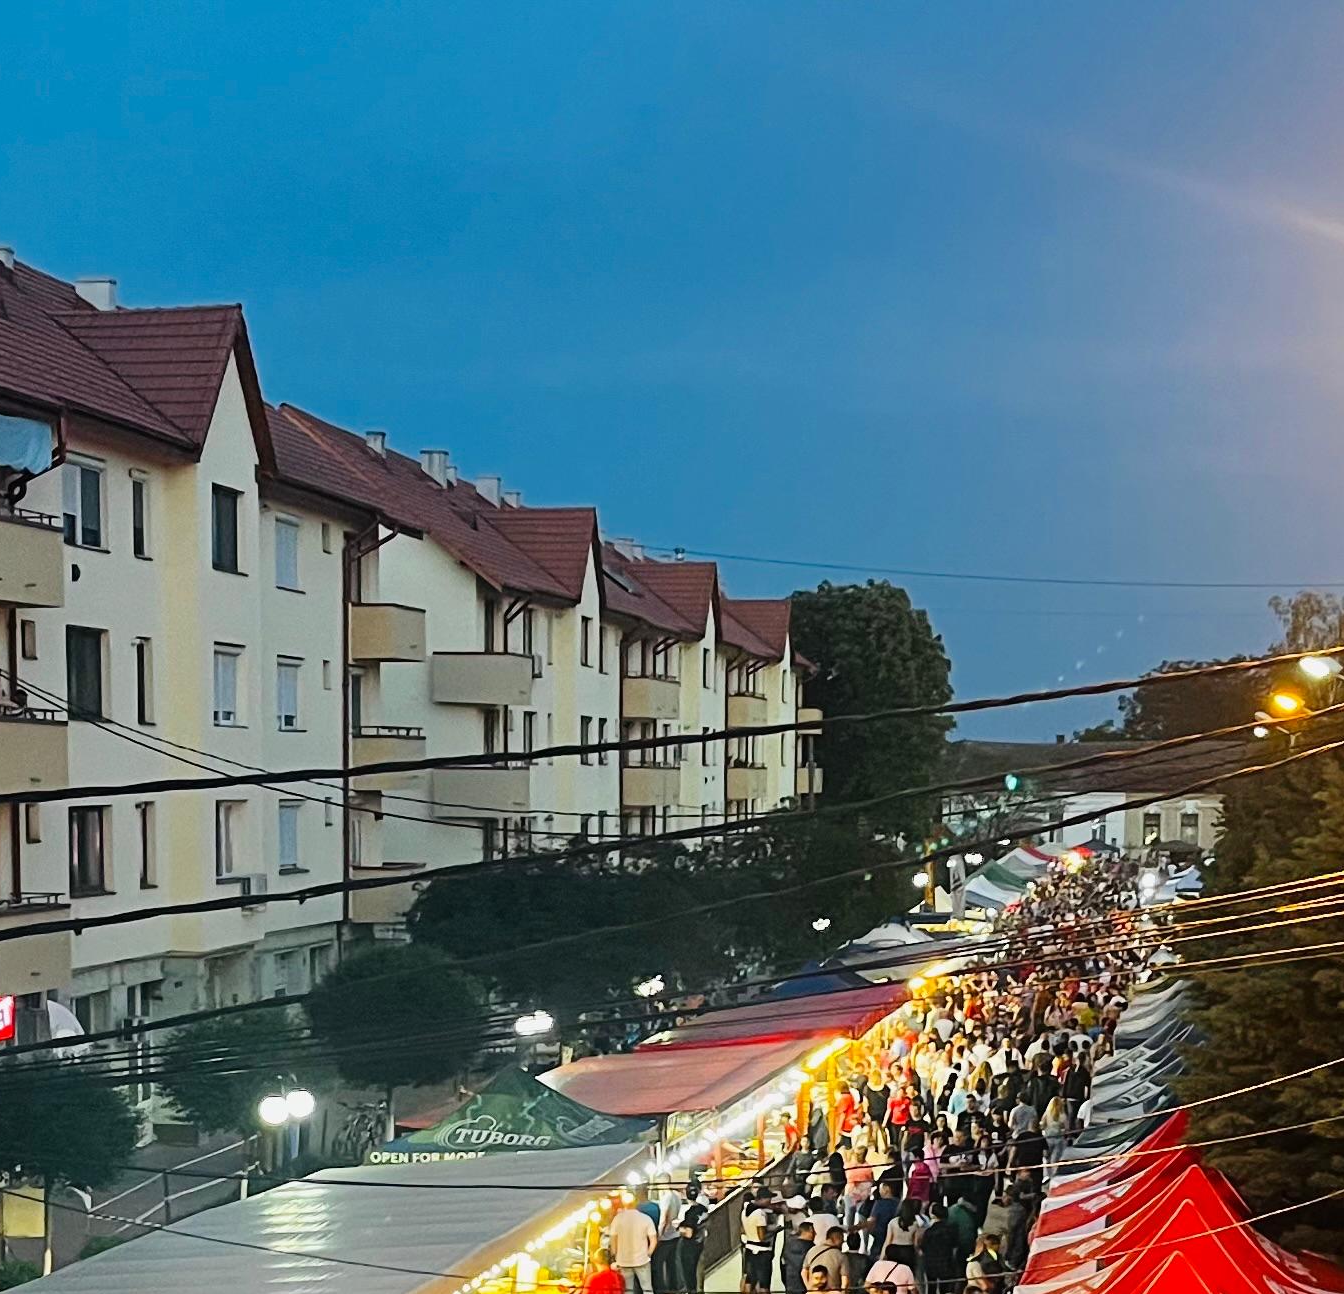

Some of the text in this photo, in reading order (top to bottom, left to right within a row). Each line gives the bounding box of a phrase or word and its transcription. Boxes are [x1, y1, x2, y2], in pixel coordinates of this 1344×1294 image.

[456, 1128, 551, 1146] TUBORG
[370, 1152, 408, 1164] OPEN
[412, 1152, 440, 1163] FOR
